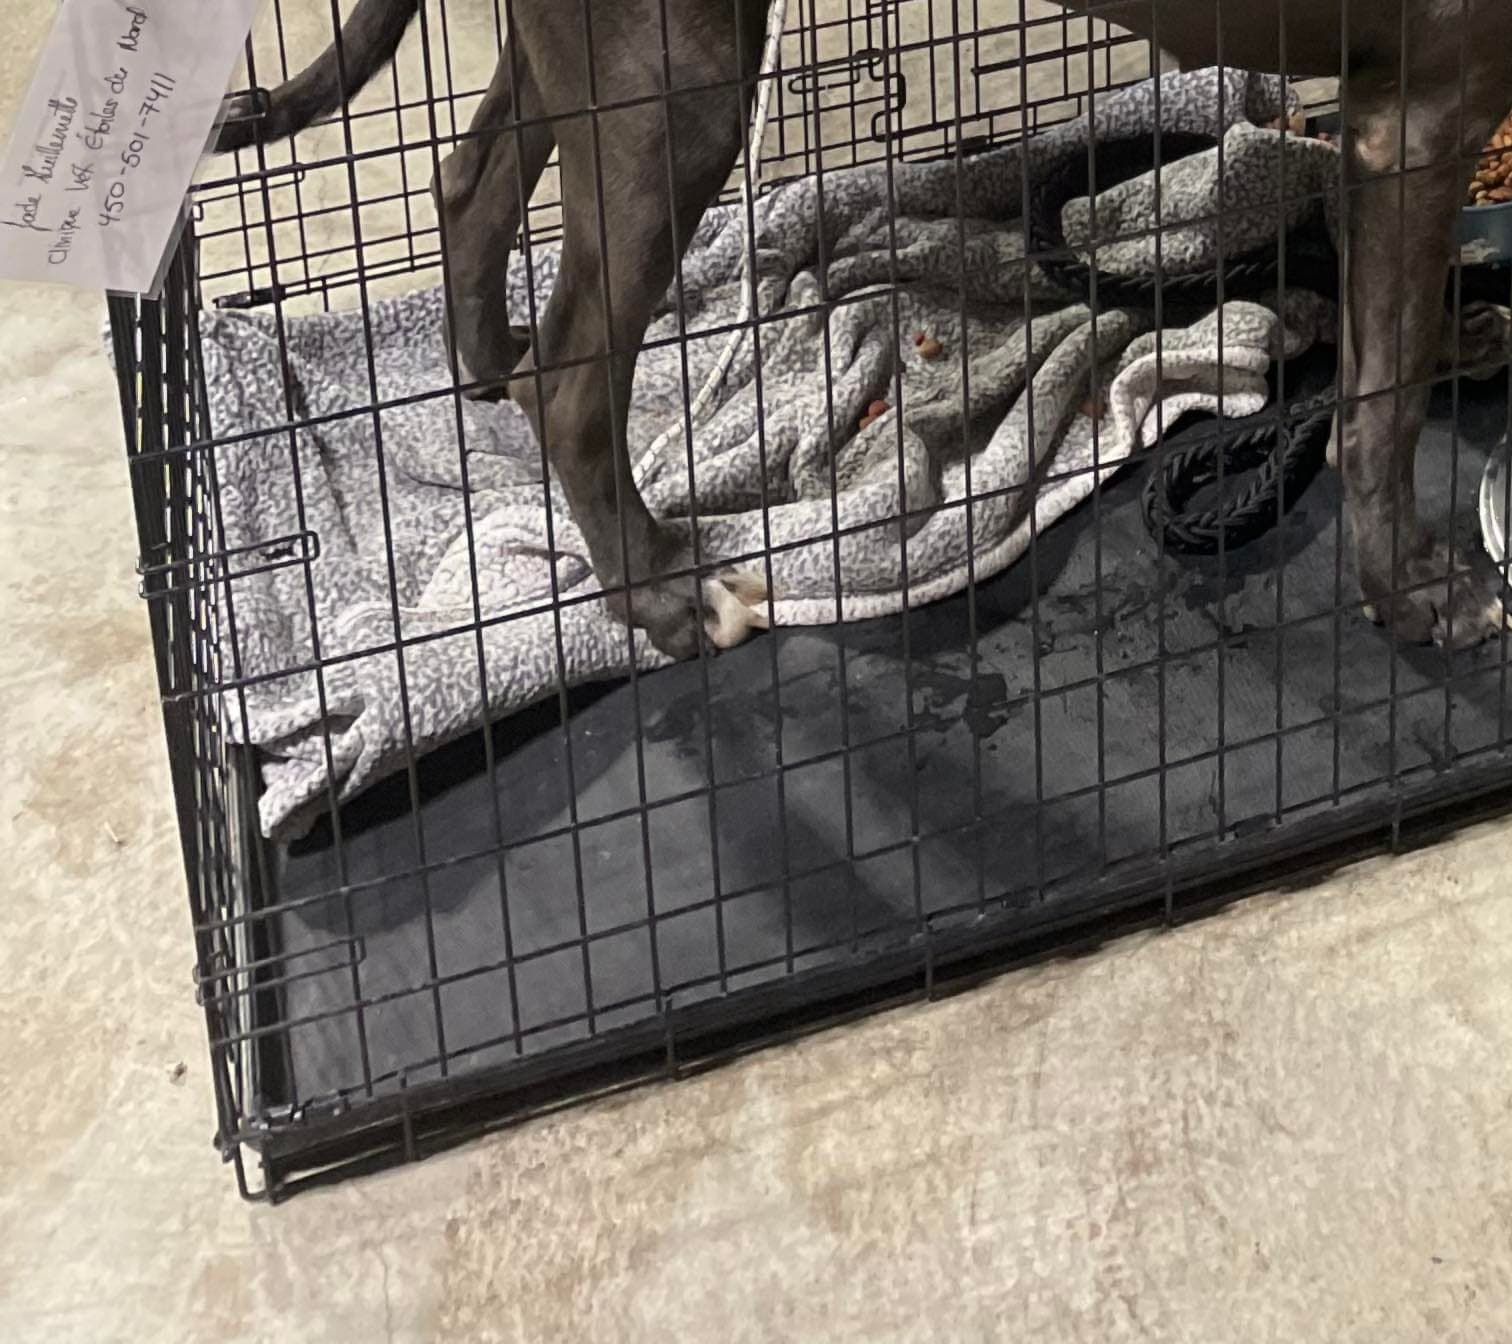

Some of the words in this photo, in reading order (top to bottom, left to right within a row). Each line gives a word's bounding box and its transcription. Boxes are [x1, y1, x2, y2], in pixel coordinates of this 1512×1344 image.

[48, 207, 81, 264] Clinique
[76, 99, 118, 150] Étoiles
[117, 6, 149, 52] Nord
[98, 72, 176, 227] 450-501-7411
[0, 194, 52, 232] Jade
